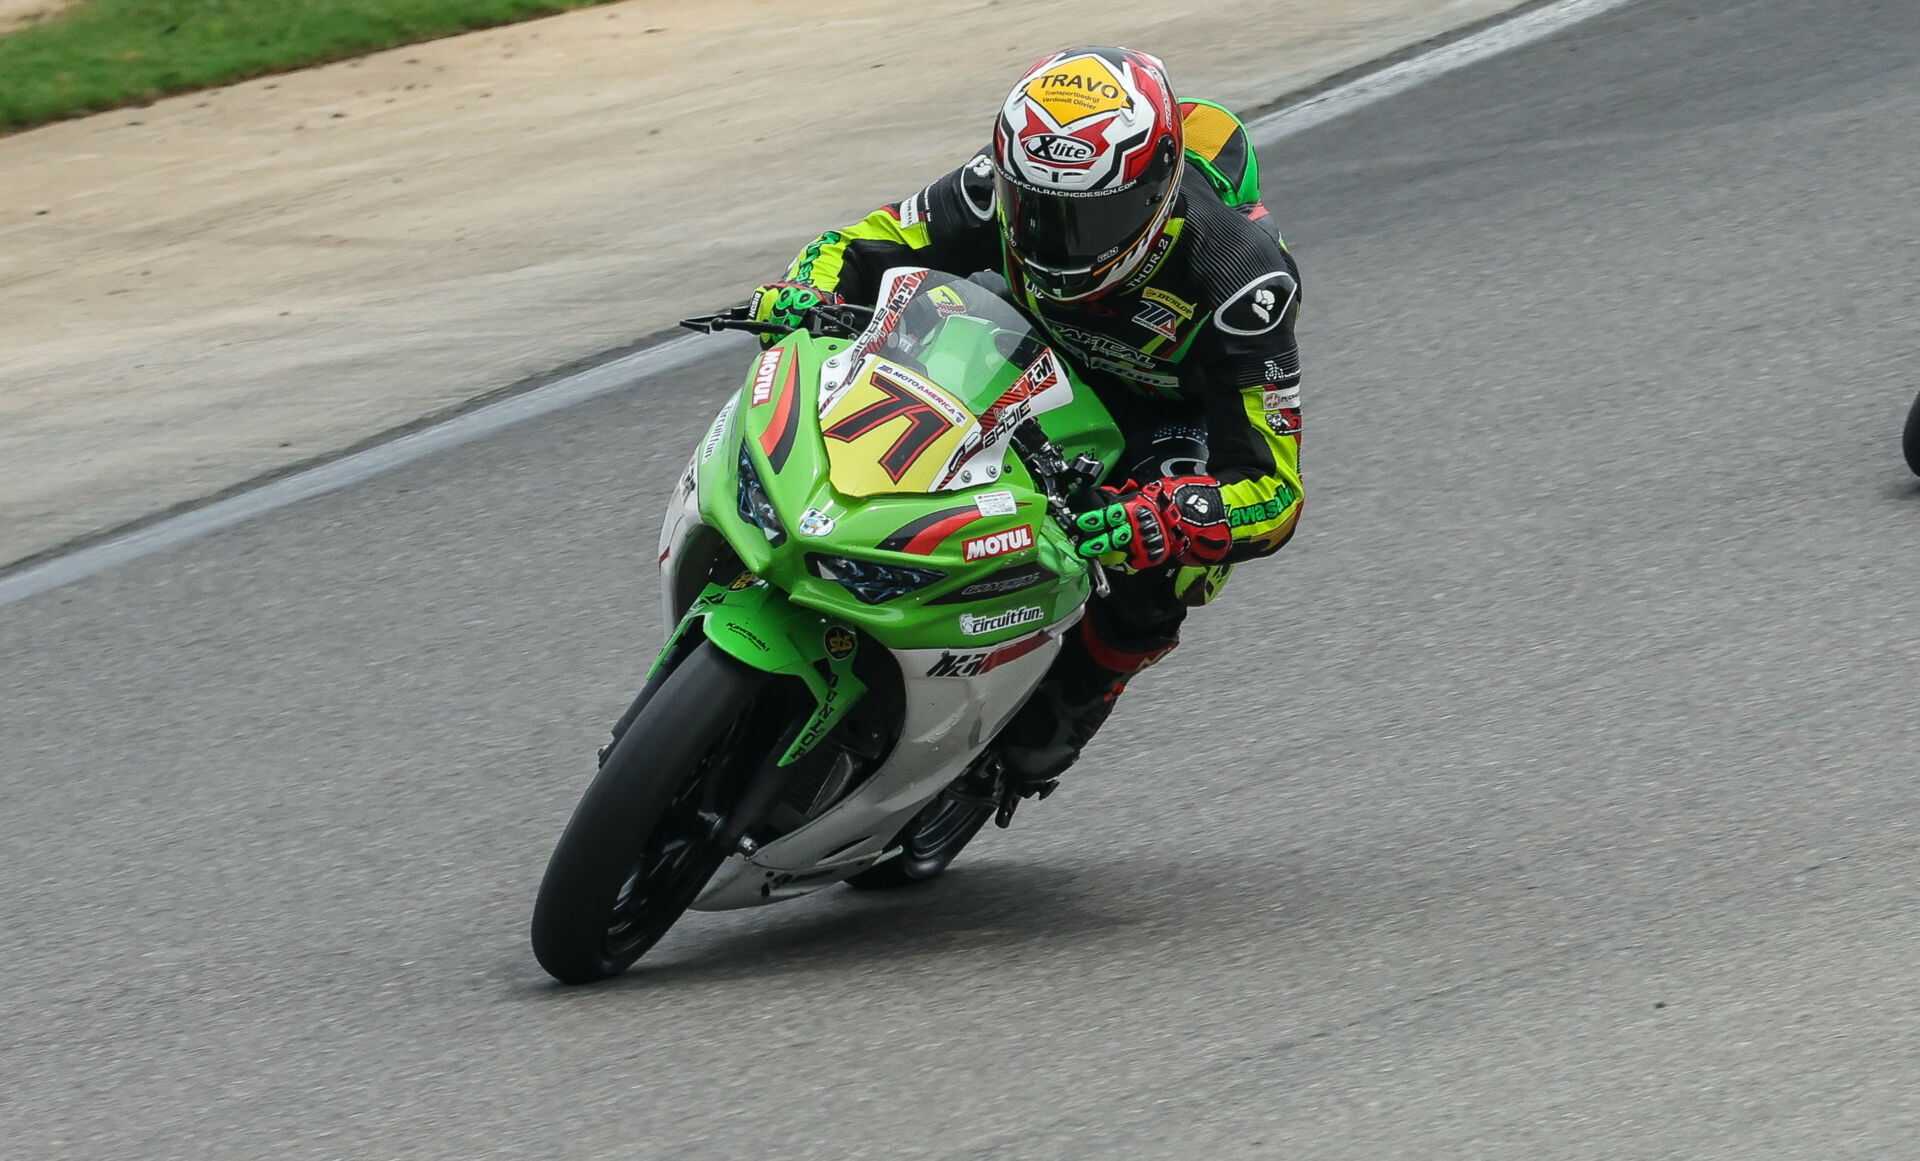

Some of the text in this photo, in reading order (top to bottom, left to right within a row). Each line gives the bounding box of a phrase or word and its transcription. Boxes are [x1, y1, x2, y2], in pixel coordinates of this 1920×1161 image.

[1040, 74, 1119, 99] TRAVO
[1073, 99, 1097, 111] Olivier
[1031, 135, 1088, 160] X-lite
[1125, 238, 1169, 287] THOR.2
[1156, 293, 1193, 314] DUNLOP
[753, 350, 781, 404] MOTUL
[892, 371, 956, 415] MOTOAMERICA
[822, 371, 955, 486] 71
[982, 400, 1032, 449] BADIE
[966, 527, 1032, 561] MOTUL
[726, 622, 771, 652] Kawasaki
